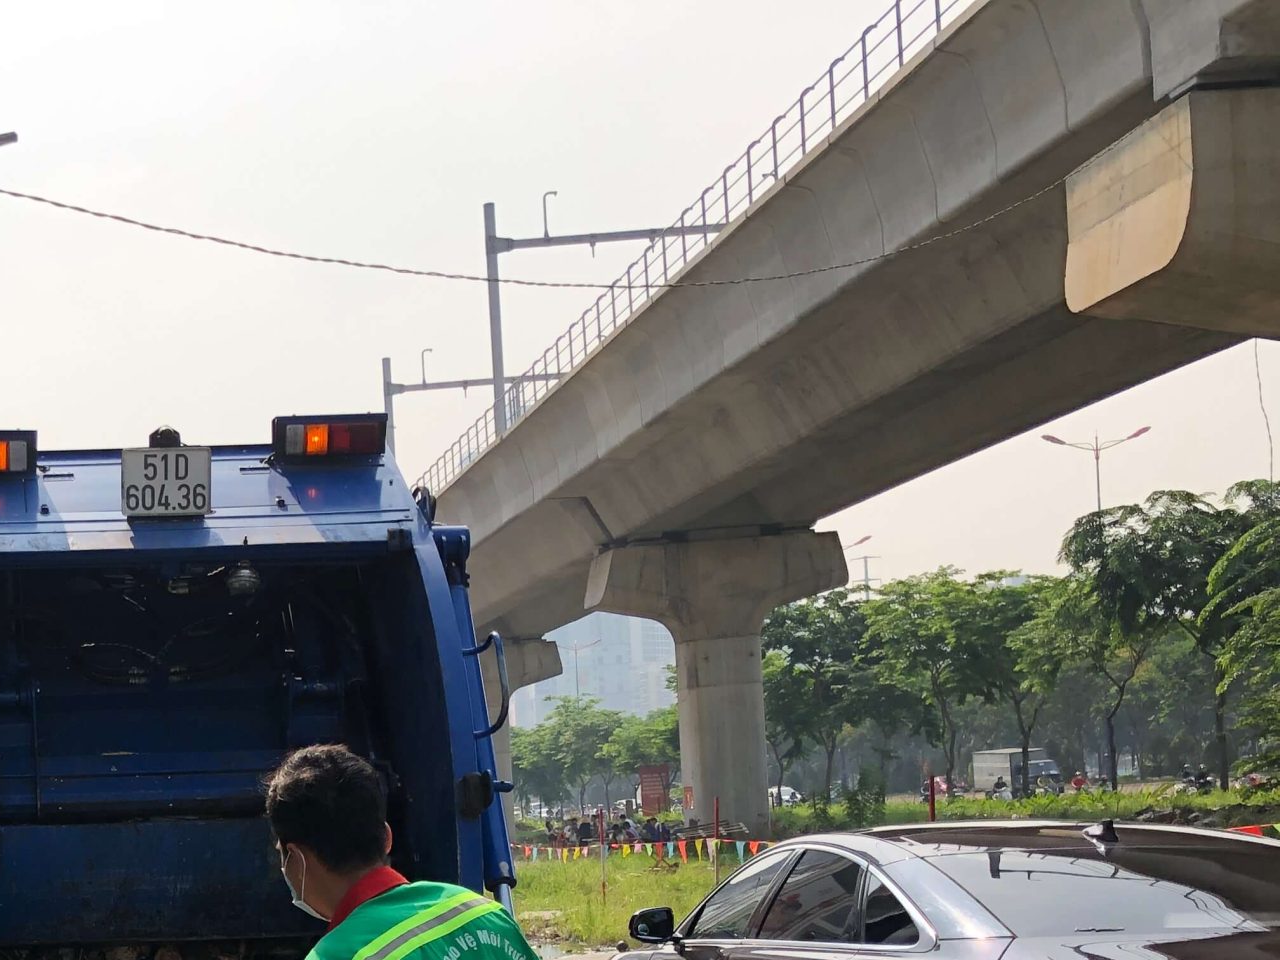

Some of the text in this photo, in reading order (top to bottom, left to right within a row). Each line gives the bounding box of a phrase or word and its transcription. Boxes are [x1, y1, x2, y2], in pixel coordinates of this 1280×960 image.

[143, 454, 189, 481] 51D
[125, 483, 207, 511] 604.36
[455, 932, 478, 951] Vệ
